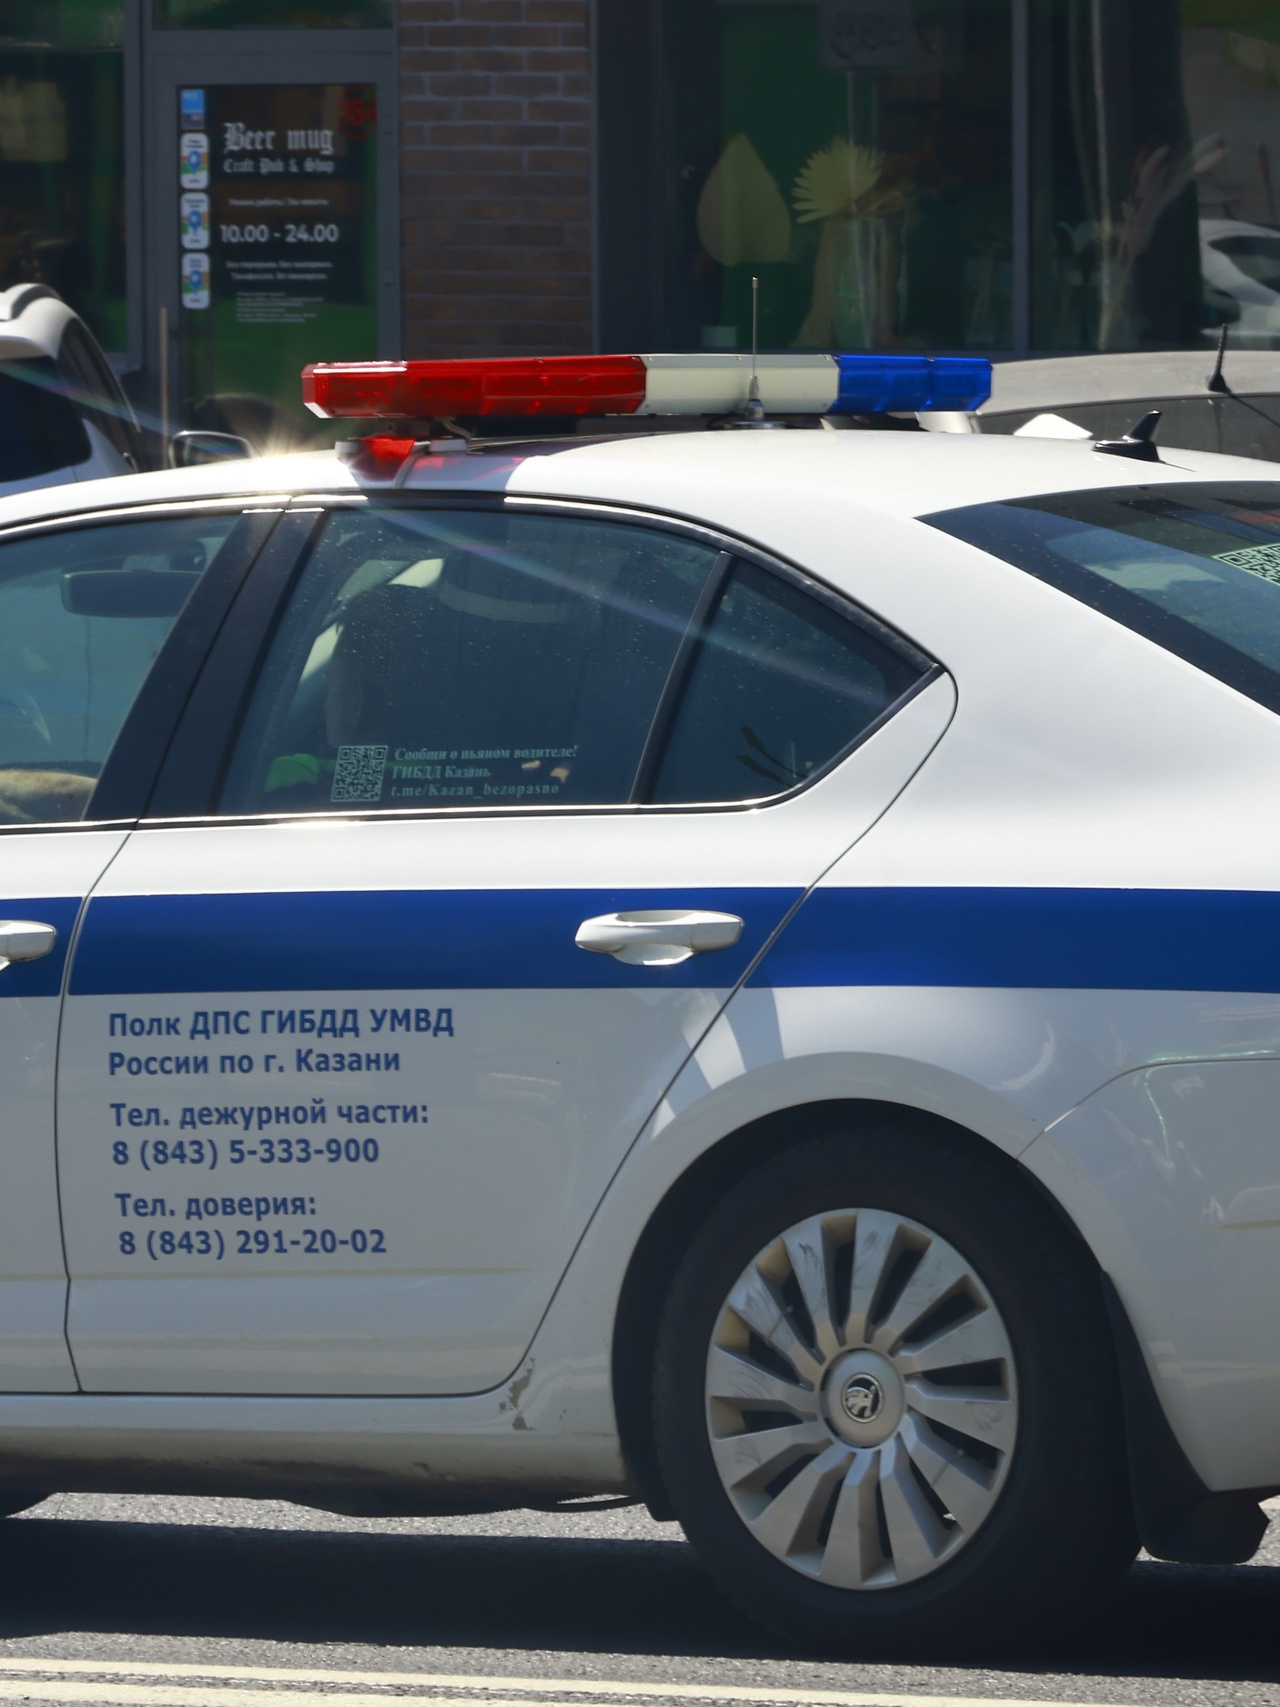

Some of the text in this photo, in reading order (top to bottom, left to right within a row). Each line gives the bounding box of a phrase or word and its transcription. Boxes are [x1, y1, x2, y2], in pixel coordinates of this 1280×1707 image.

[222, 121, 334, 156] Beer mug
[219, 223, 270, 244] 10.00
[284, 223, 341, 244] 24.00
[394, 745, 580, 762] Сообщи о пьяном водителе!
[391, 765, 492, 780] ГИБДД Казань
[390, 783, 560, 799] t.me/Kazan_bezopasno
[109, 1008, 455, 1040] Полк ДПС ГИБДД УМВД
[109, 1049, 400, 1076] России по г. Казани
[110, 1098, 429, 1131] Тел. дежурной части:
[112, 1138, 379, 1171] 8 (843) 5-333-900
[115, 1193, 316, 1221] Тел. доверия:
[119, 1229, 387, 1261] 8 (843) 291-20-02
